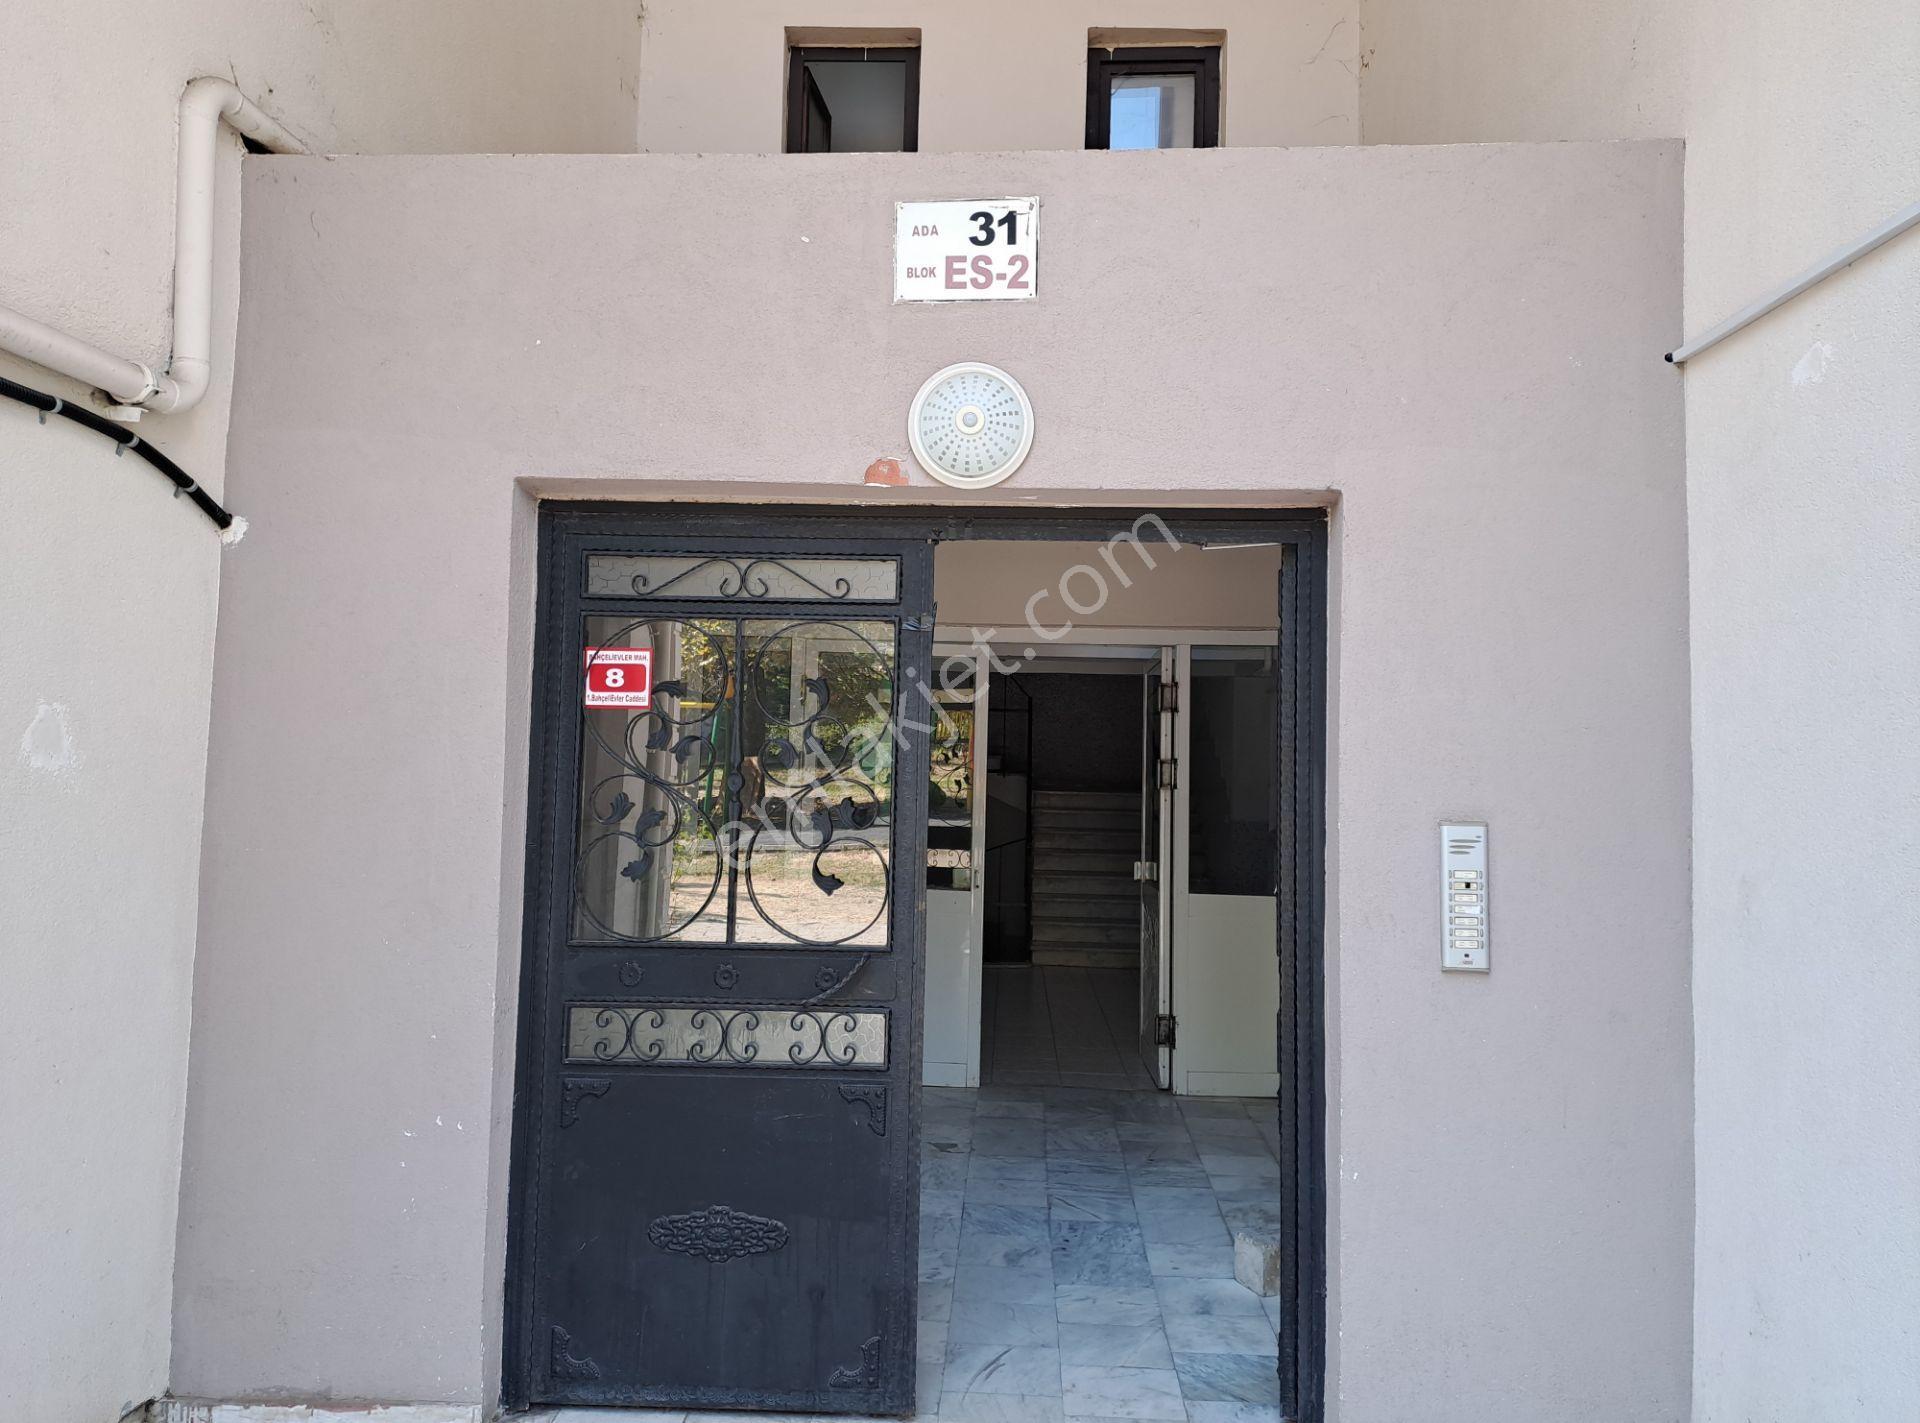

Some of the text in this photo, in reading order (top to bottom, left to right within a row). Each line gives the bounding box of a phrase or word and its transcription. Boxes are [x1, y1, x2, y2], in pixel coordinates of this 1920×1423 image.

[912, 210, 1017, 246] ADA 31
[906, 254, 1029, 289] BLOK ES-2
[605, 668, 625, 688] 8
[625, 694, 646, 703] Caddesi
